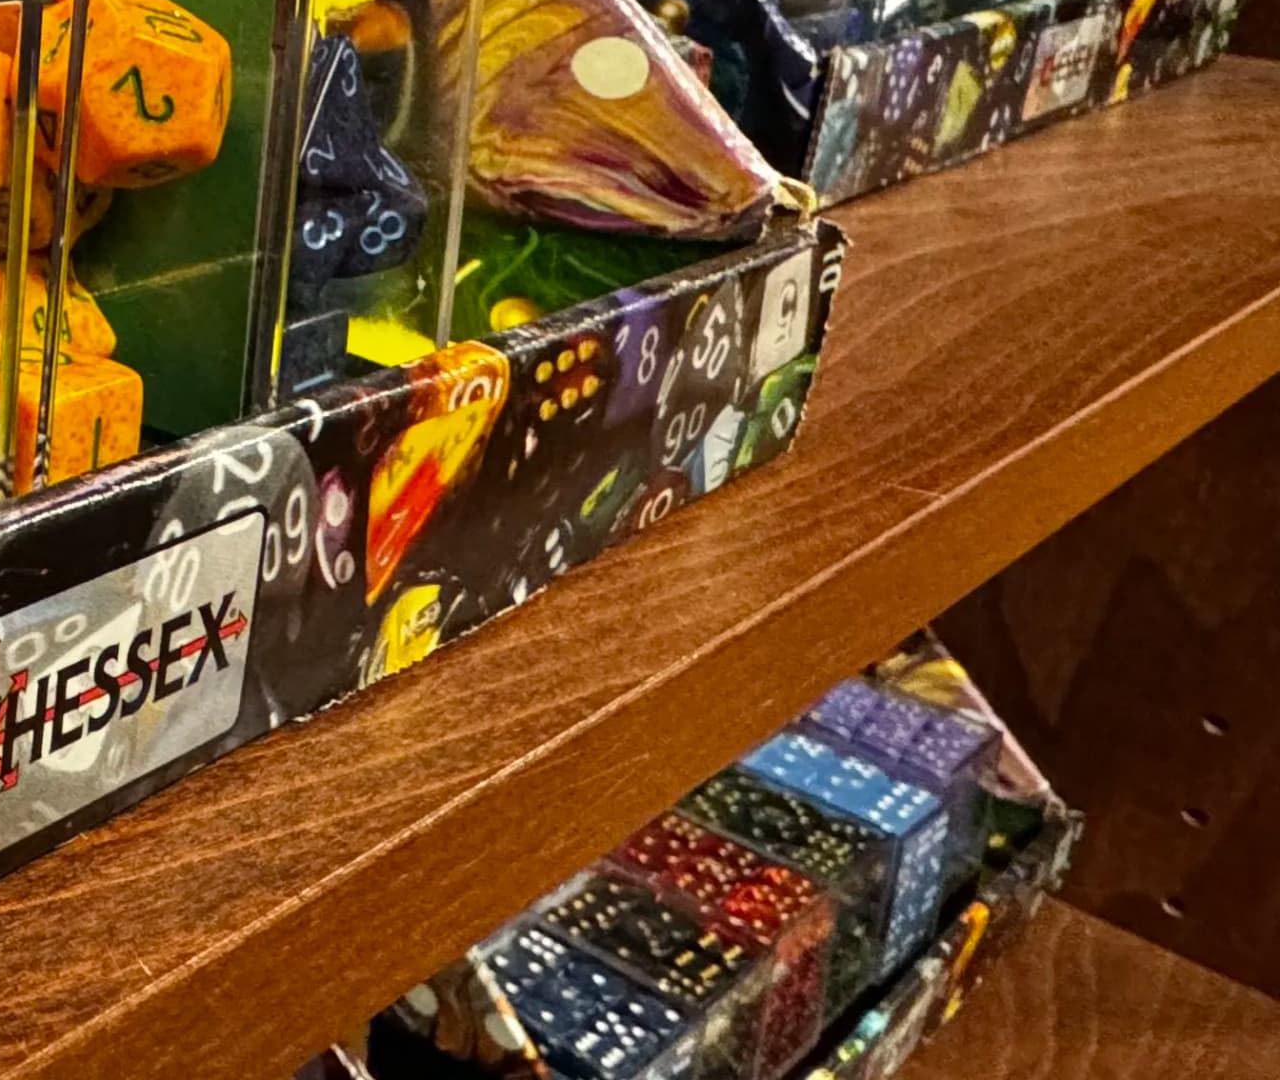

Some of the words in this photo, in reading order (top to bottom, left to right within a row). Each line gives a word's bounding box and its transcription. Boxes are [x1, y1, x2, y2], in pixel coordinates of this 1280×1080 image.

[110, 65, 175, 123] 2
[341, 46, 359, 98] 3
[306, 135, 338, 177] 2
[302, 210, 345, 250] 3
